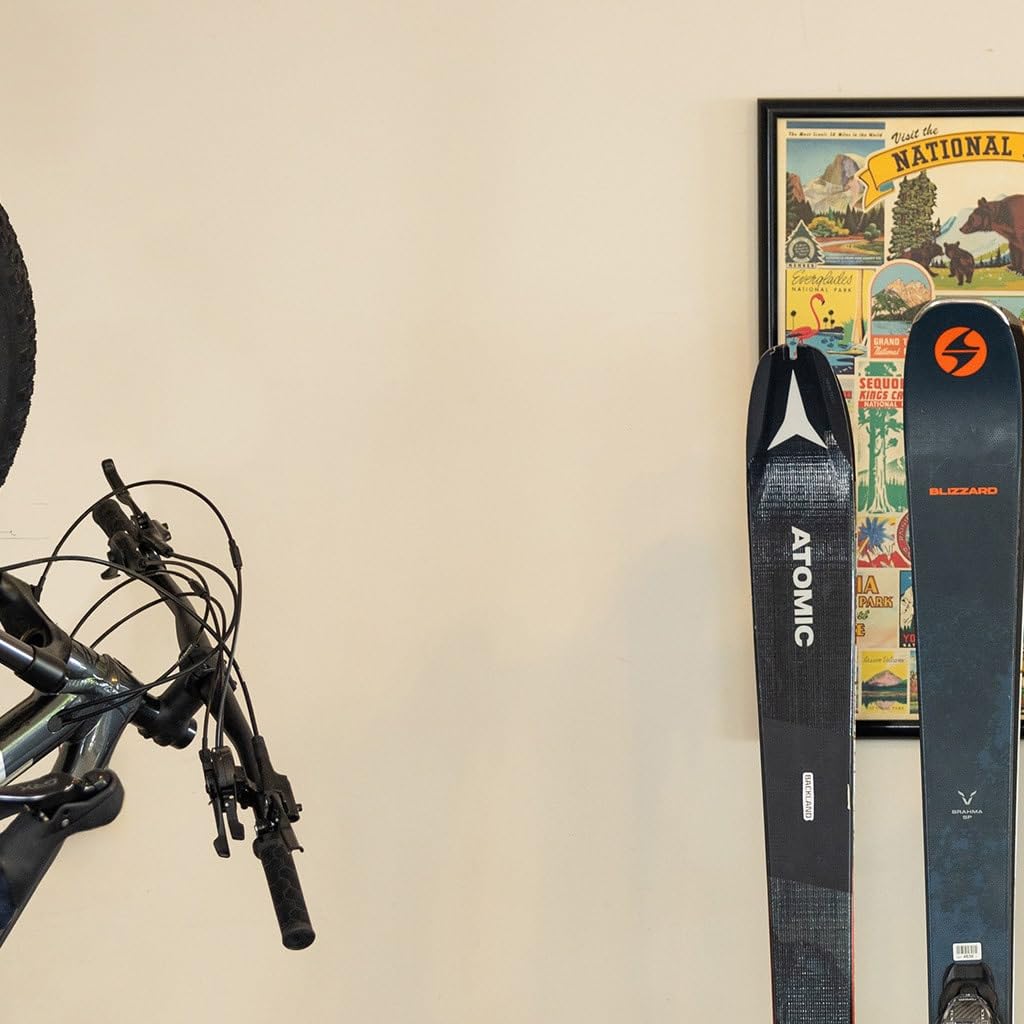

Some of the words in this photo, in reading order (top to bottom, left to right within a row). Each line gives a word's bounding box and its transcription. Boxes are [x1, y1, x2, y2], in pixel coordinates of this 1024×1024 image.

[891, 130, 920, 145] Visit
[922, 124, 939, 137] the
[891, 135, 1012, 172] NATIONAL
[791, 270, 854, 287] Everglades
[873, 337, 900, 346] GRAND
[860, 391, 888, 400] KINGS
[929, 486, 999, 496] BLIZZARD
[790, 526, 815, 648] ATOMIC
[859, 596, 893, 608] PARK
[804, 774, 812, 819] BACKLAND
